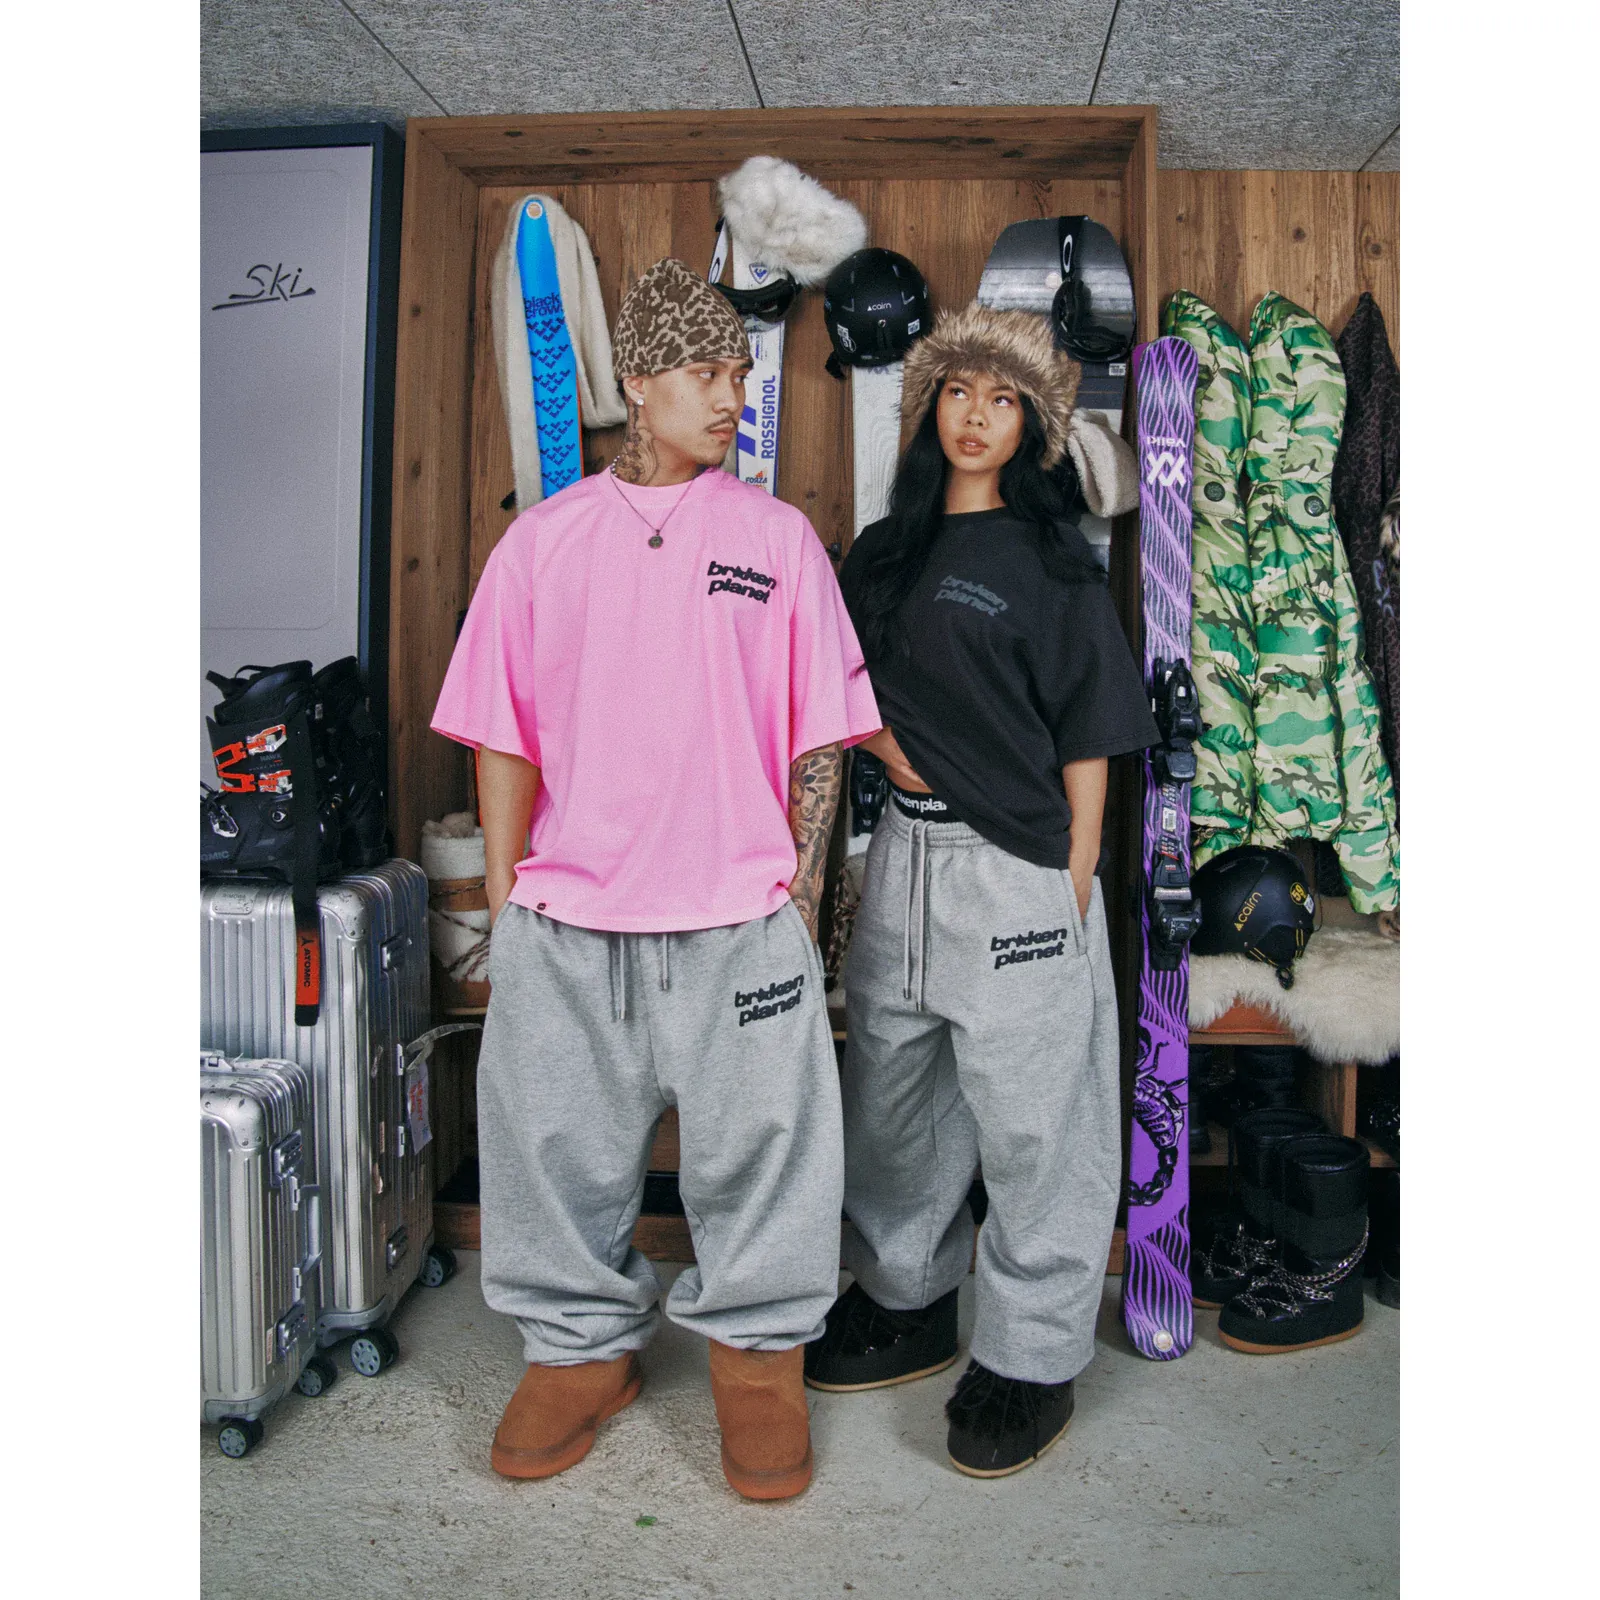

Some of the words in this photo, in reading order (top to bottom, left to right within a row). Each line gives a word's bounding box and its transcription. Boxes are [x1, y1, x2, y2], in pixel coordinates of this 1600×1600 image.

[228, 263, 316, 302] Ski
[871, 302, 892, 311] cairn
[760, 375, 776, 460] ROSSIGNOL
[707, 578, 771, 605] planet
[1238, 891, 1263, 923] cairn
[1291, 884, 1307, 902] 59
[303, 947, 312, 988] ATOMIC
[993, 941, 1066, 970] planet
[738, 988, 802, 1027] planet
